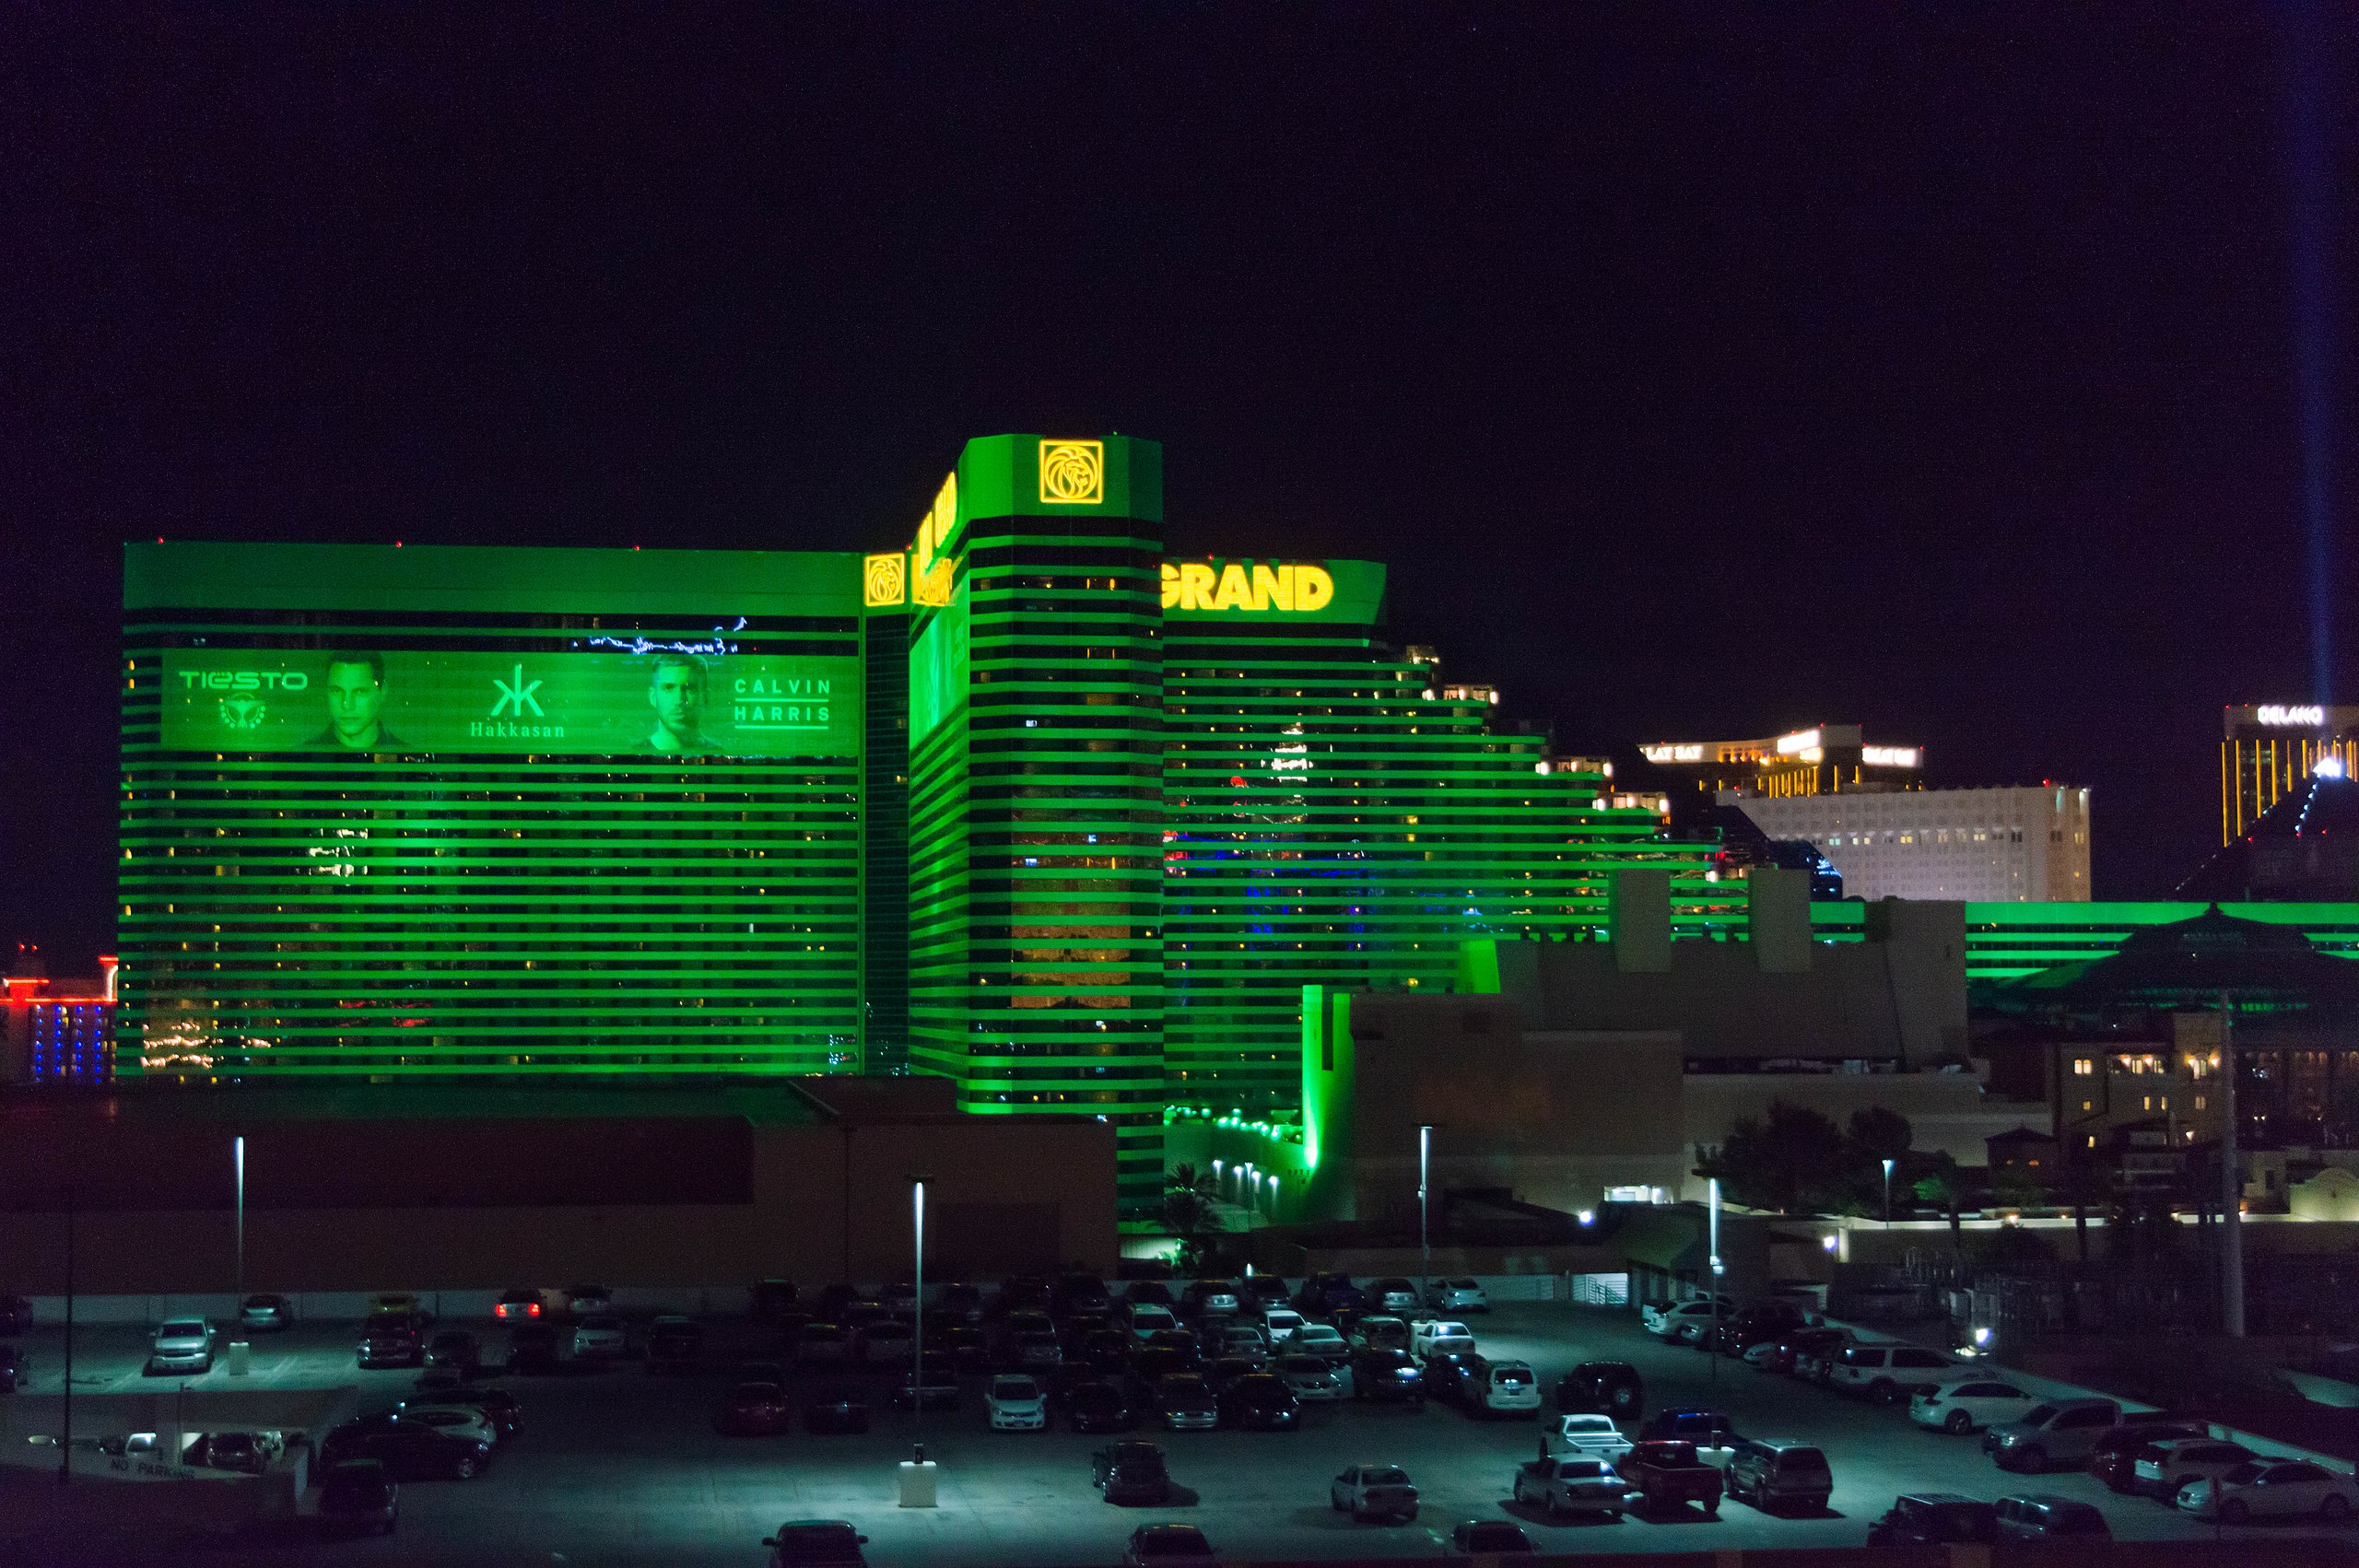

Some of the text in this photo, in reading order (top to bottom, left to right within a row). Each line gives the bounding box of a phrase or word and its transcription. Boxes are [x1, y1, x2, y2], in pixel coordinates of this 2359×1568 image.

[734, 678, 829, 694] CALVIN
[734, 706, 829, 721] HARRIS
[2258, 706, 2324, 725] DELANO
[471, 721, 565, 738] Hakkasan
[1644, 744, 1703, 761] LAY BAY
